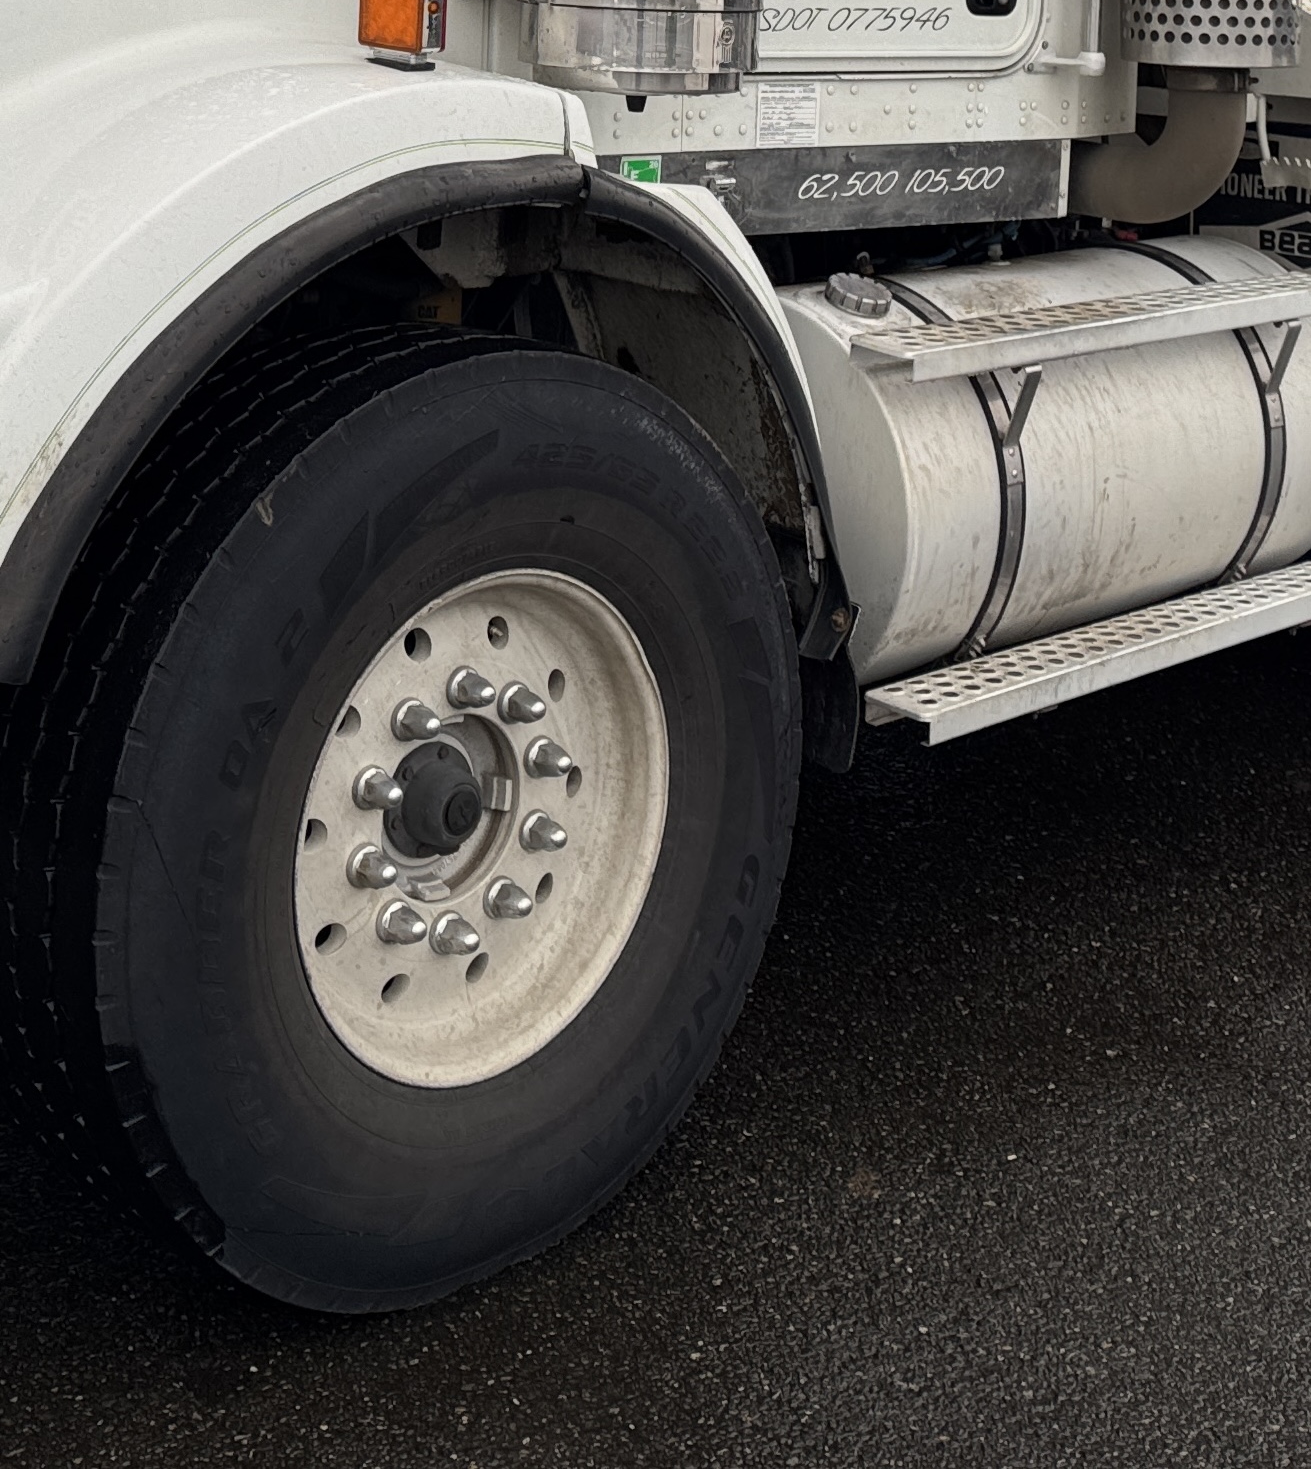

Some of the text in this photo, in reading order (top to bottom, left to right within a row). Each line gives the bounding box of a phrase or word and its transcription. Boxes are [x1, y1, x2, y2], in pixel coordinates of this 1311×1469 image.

[760, 7, 952, 32] SDOT 0775946
[798, 166, 1004, 201] 62,500 105,500
[1219, 173, 1288, 203] IONEER
[418, 304, 441, 320] CAT
